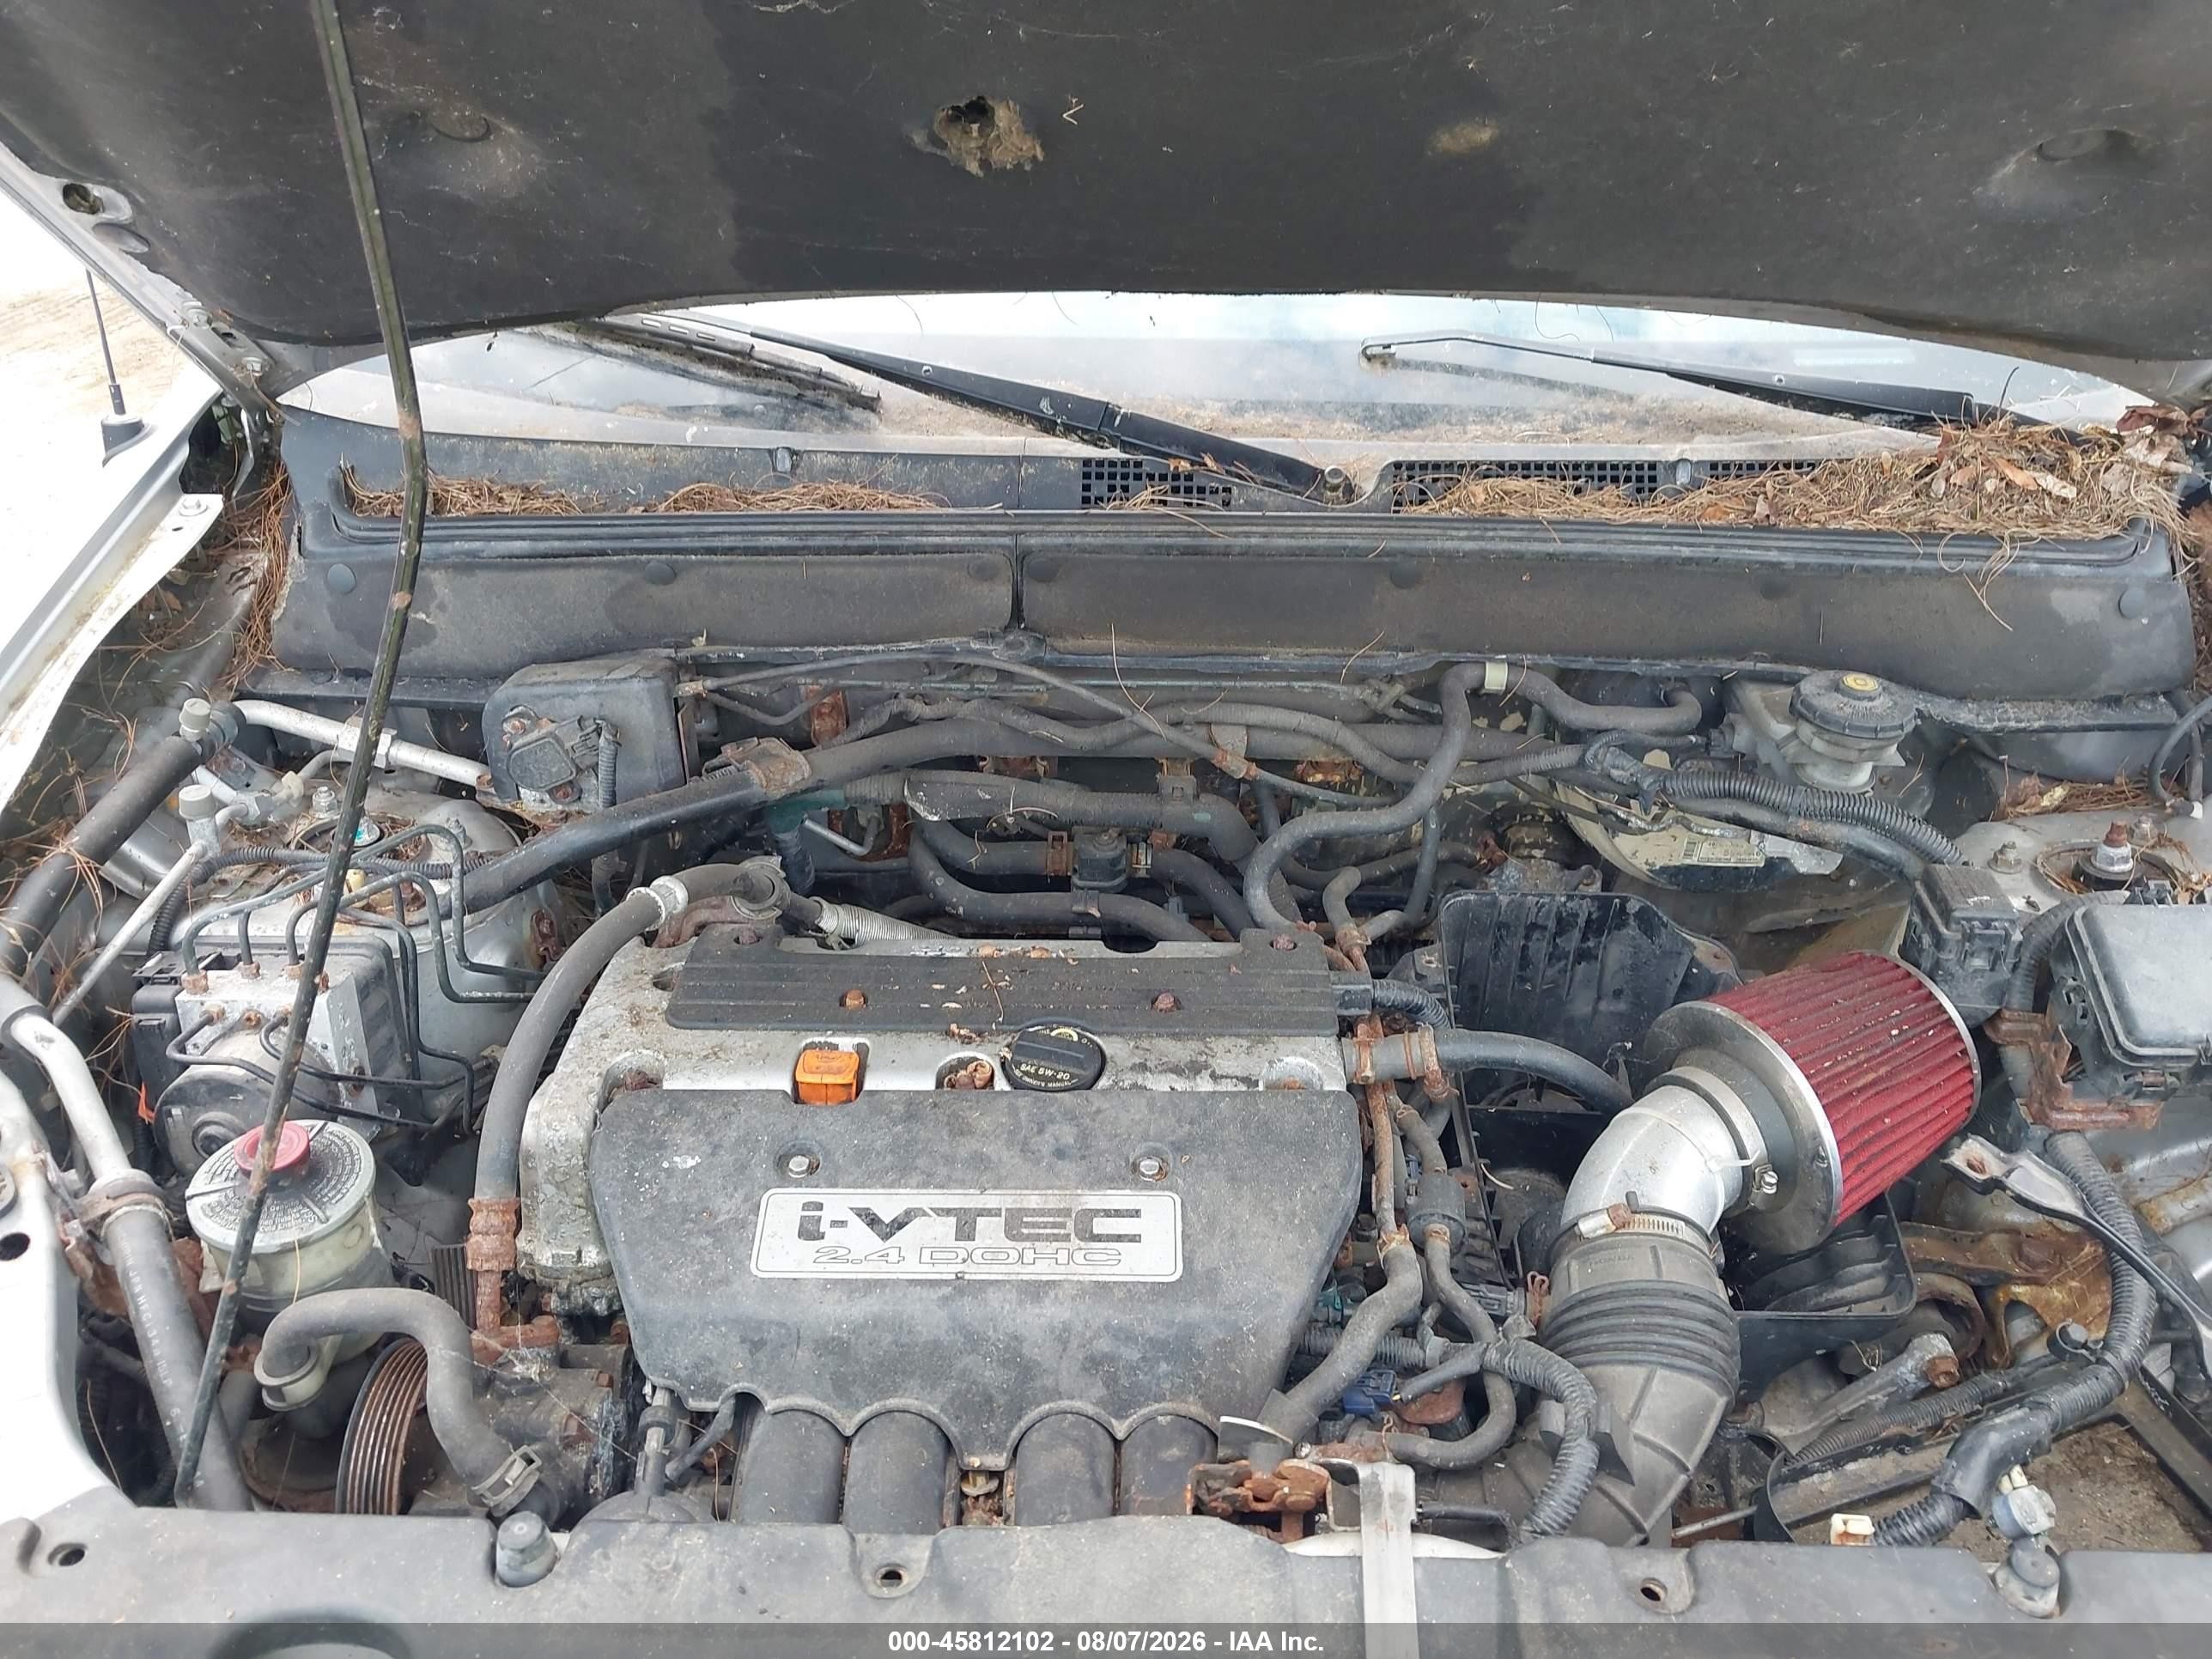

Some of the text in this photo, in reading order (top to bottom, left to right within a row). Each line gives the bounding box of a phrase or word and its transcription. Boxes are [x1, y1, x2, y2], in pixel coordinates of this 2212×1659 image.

[1020, 1063, 1036, 1074] SAE
[798, 1200, 1142, 1243] i-VTEC
[813, 1246, 1122, 1266] 2.4 DOHC
